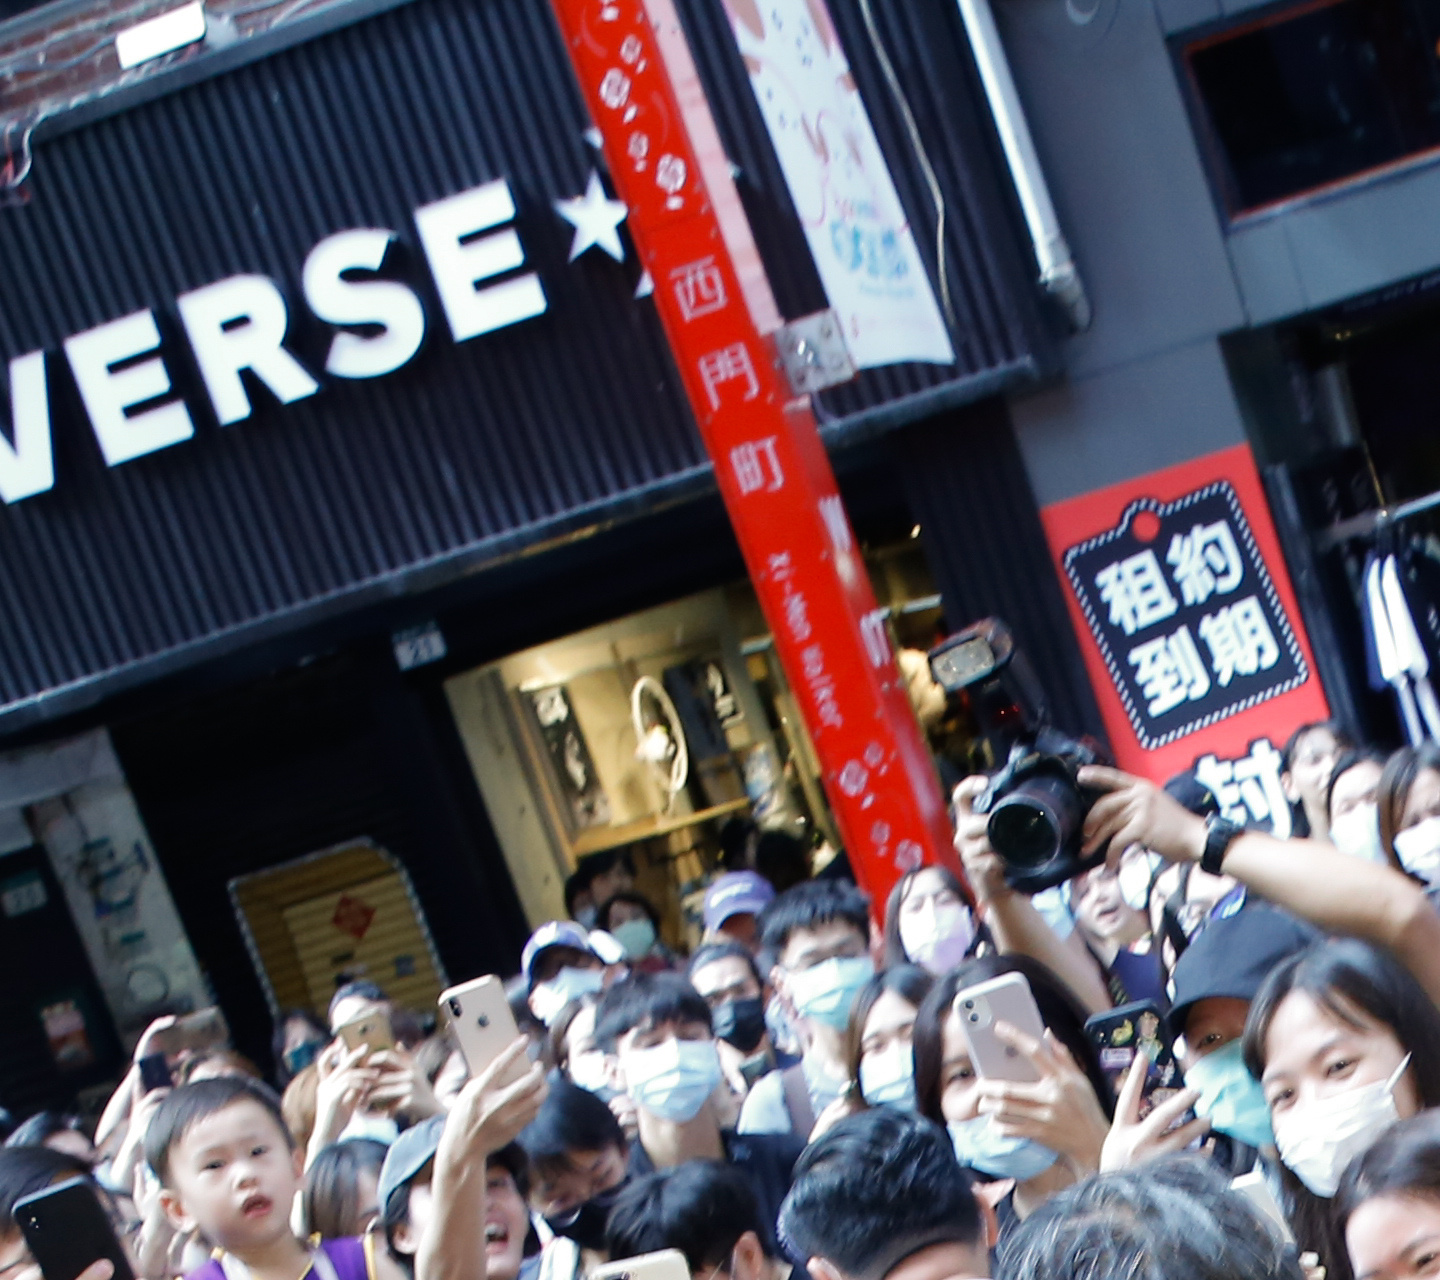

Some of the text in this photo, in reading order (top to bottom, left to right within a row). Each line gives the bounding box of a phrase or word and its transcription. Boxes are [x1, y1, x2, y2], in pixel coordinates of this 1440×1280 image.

[668, 255, 785, 497] 西門町
[1094, 519, 1244, 636] 租約
[1127, 594, 1281, 719] 到期
